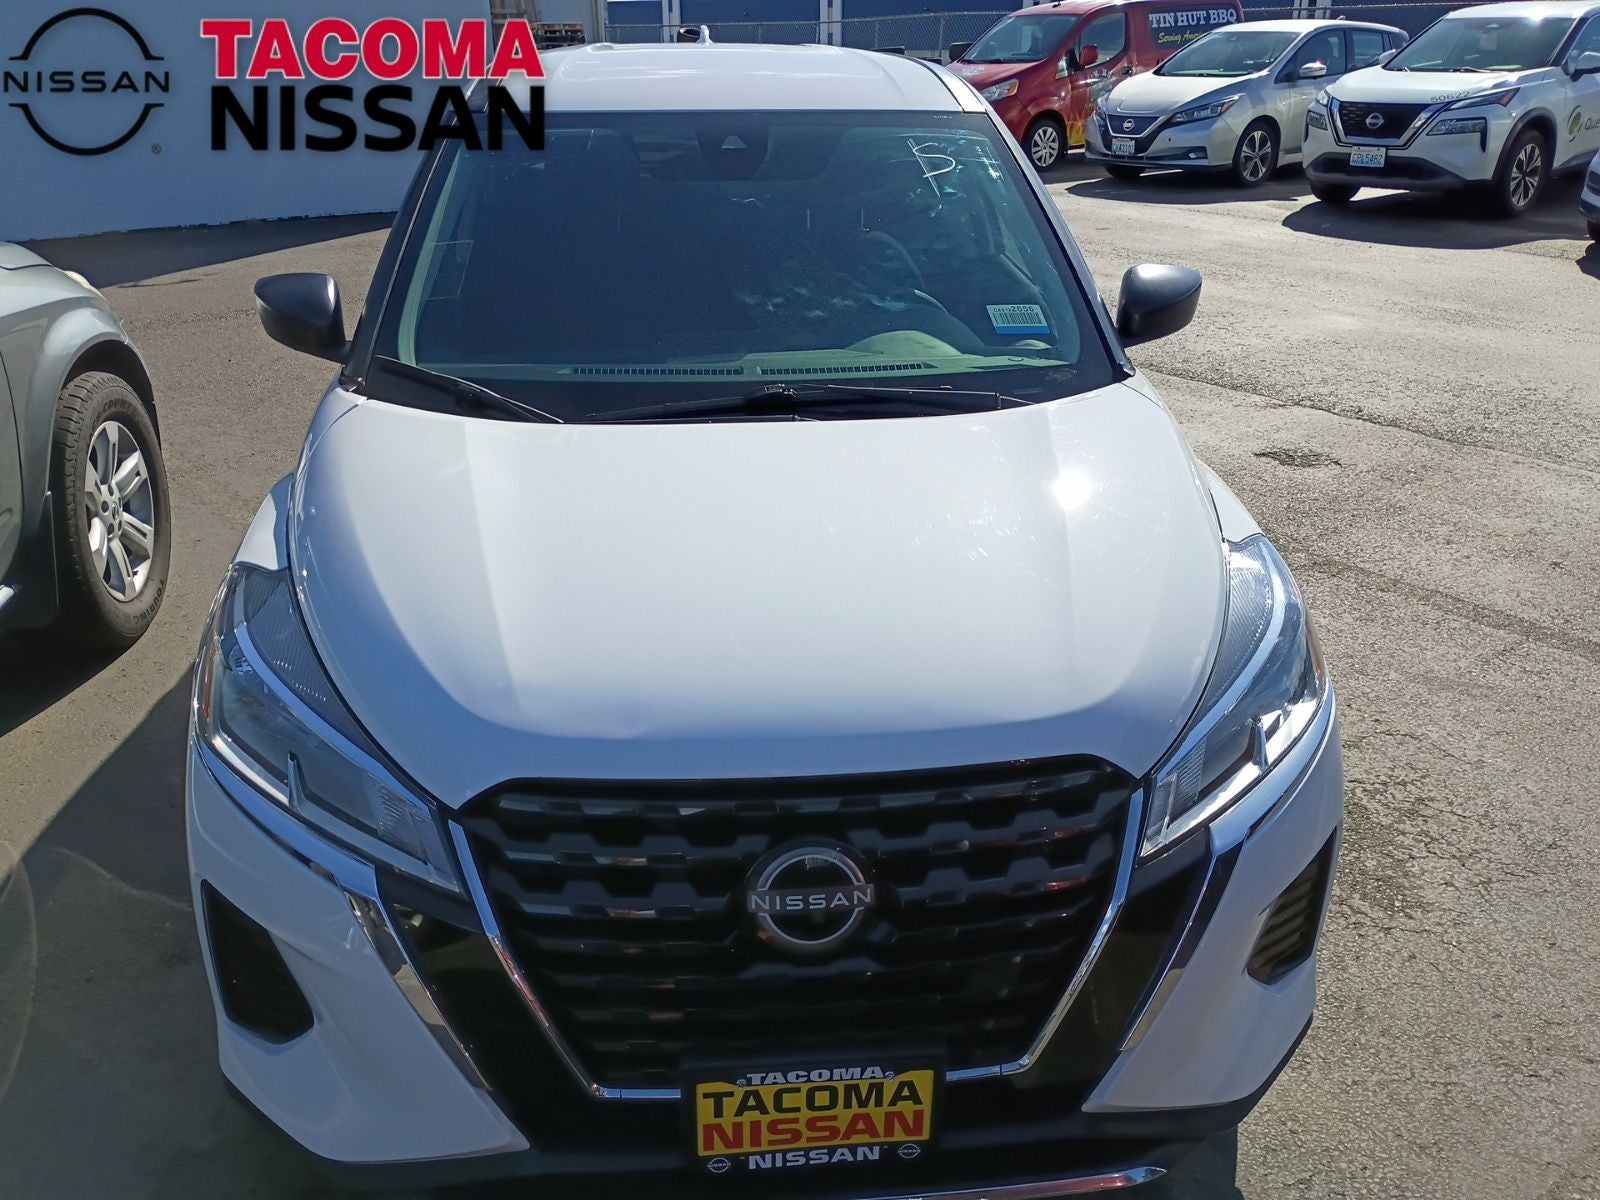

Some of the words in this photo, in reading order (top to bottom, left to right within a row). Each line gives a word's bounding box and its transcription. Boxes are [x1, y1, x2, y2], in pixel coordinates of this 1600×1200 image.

[1149, 13, 1175, 28] TIN
[1176, 11, 1206, 26] HUT
[1208, 8, 1237, 24] BBQ
[751, 888, 871, 911] NISSAN
[747, 1066, 886, 1086] TACOMA
[702, 1079, 924, 1118] TACOMA
[702, 1109, 925, 1152] NISSAN
[748, 1145, 881, 1170] NISSAN
